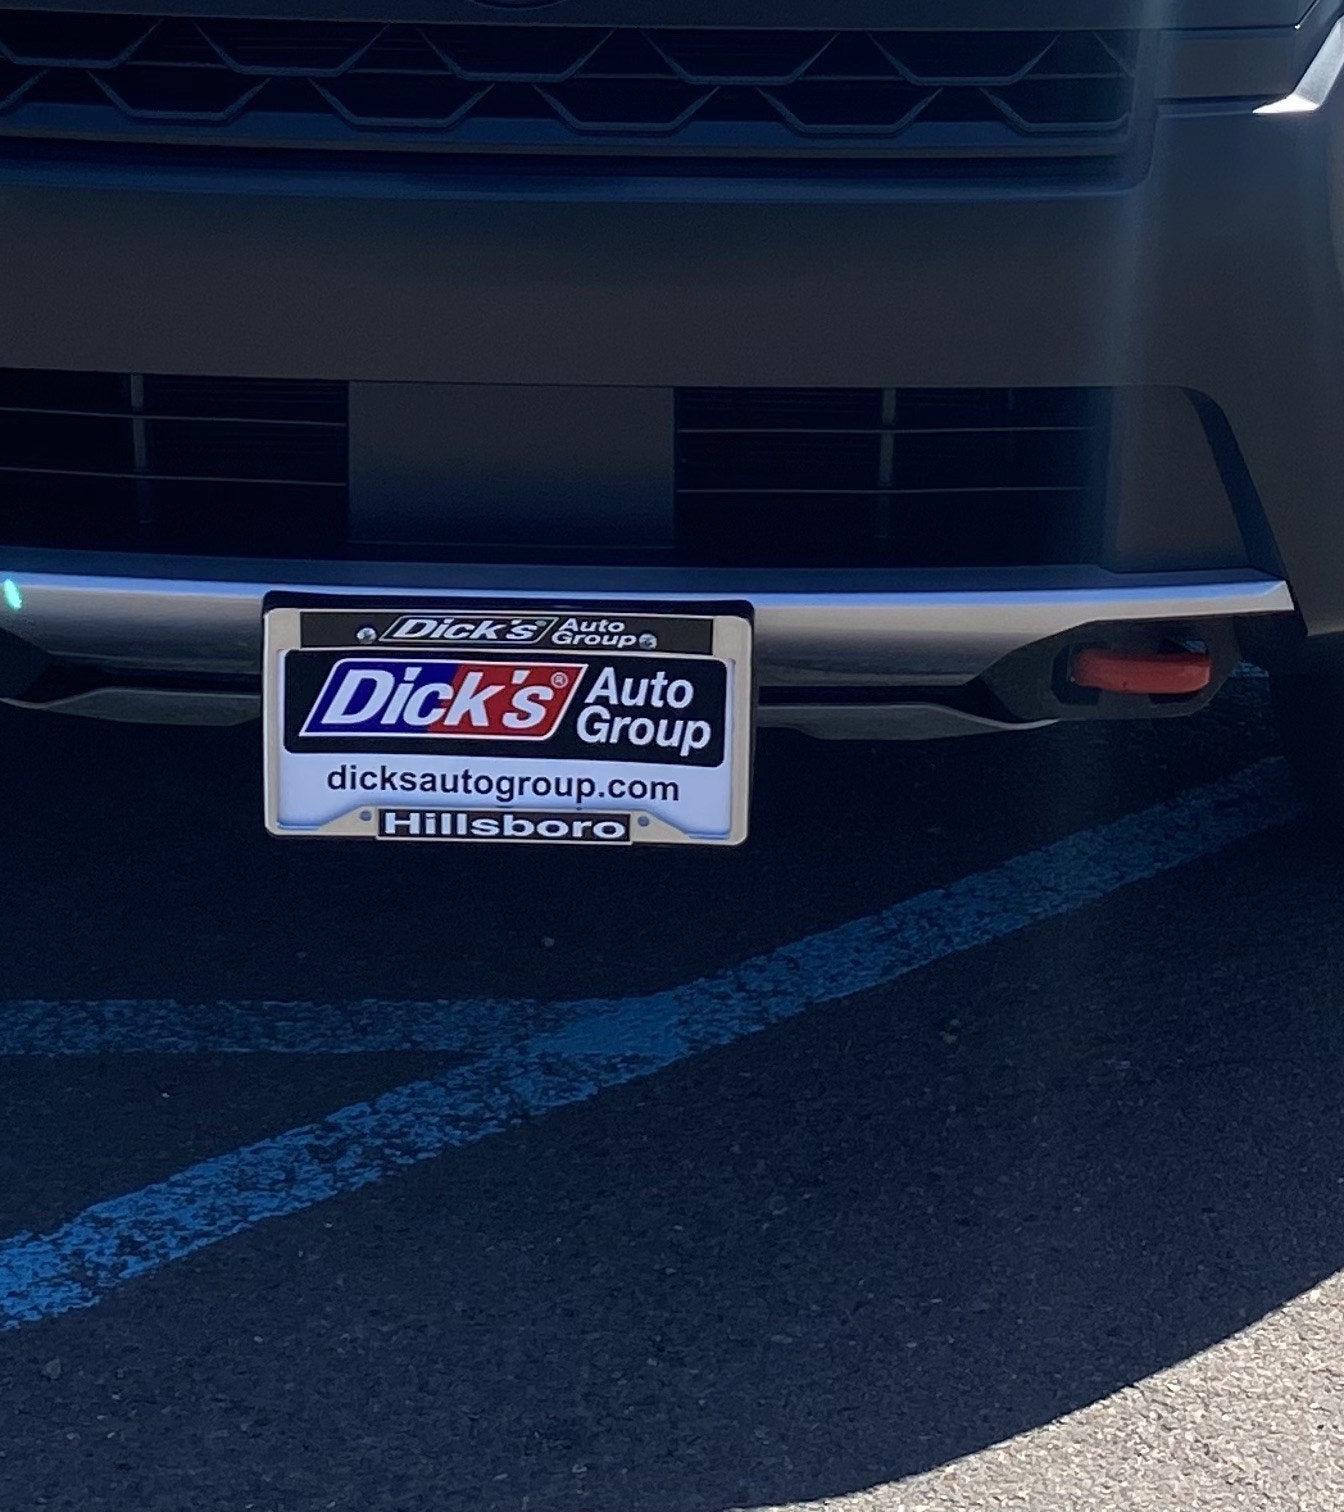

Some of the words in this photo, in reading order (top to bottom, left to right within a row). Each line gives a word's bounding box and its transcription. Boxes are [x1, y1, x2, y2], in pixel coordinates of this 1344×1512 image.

[393, 618, 538, 641] Dick's
[558, 617, 626, 633] Auto
[551, 631, 637, 649] Group
[320, 667, 552, 729] Dick's
[584, 666, 694, 709] Auto
[576, 705, 712, 757] Group
[326, 764, 680, 803] dicksautogroup.com
[384, 812, 626, 839] Hillsboro
